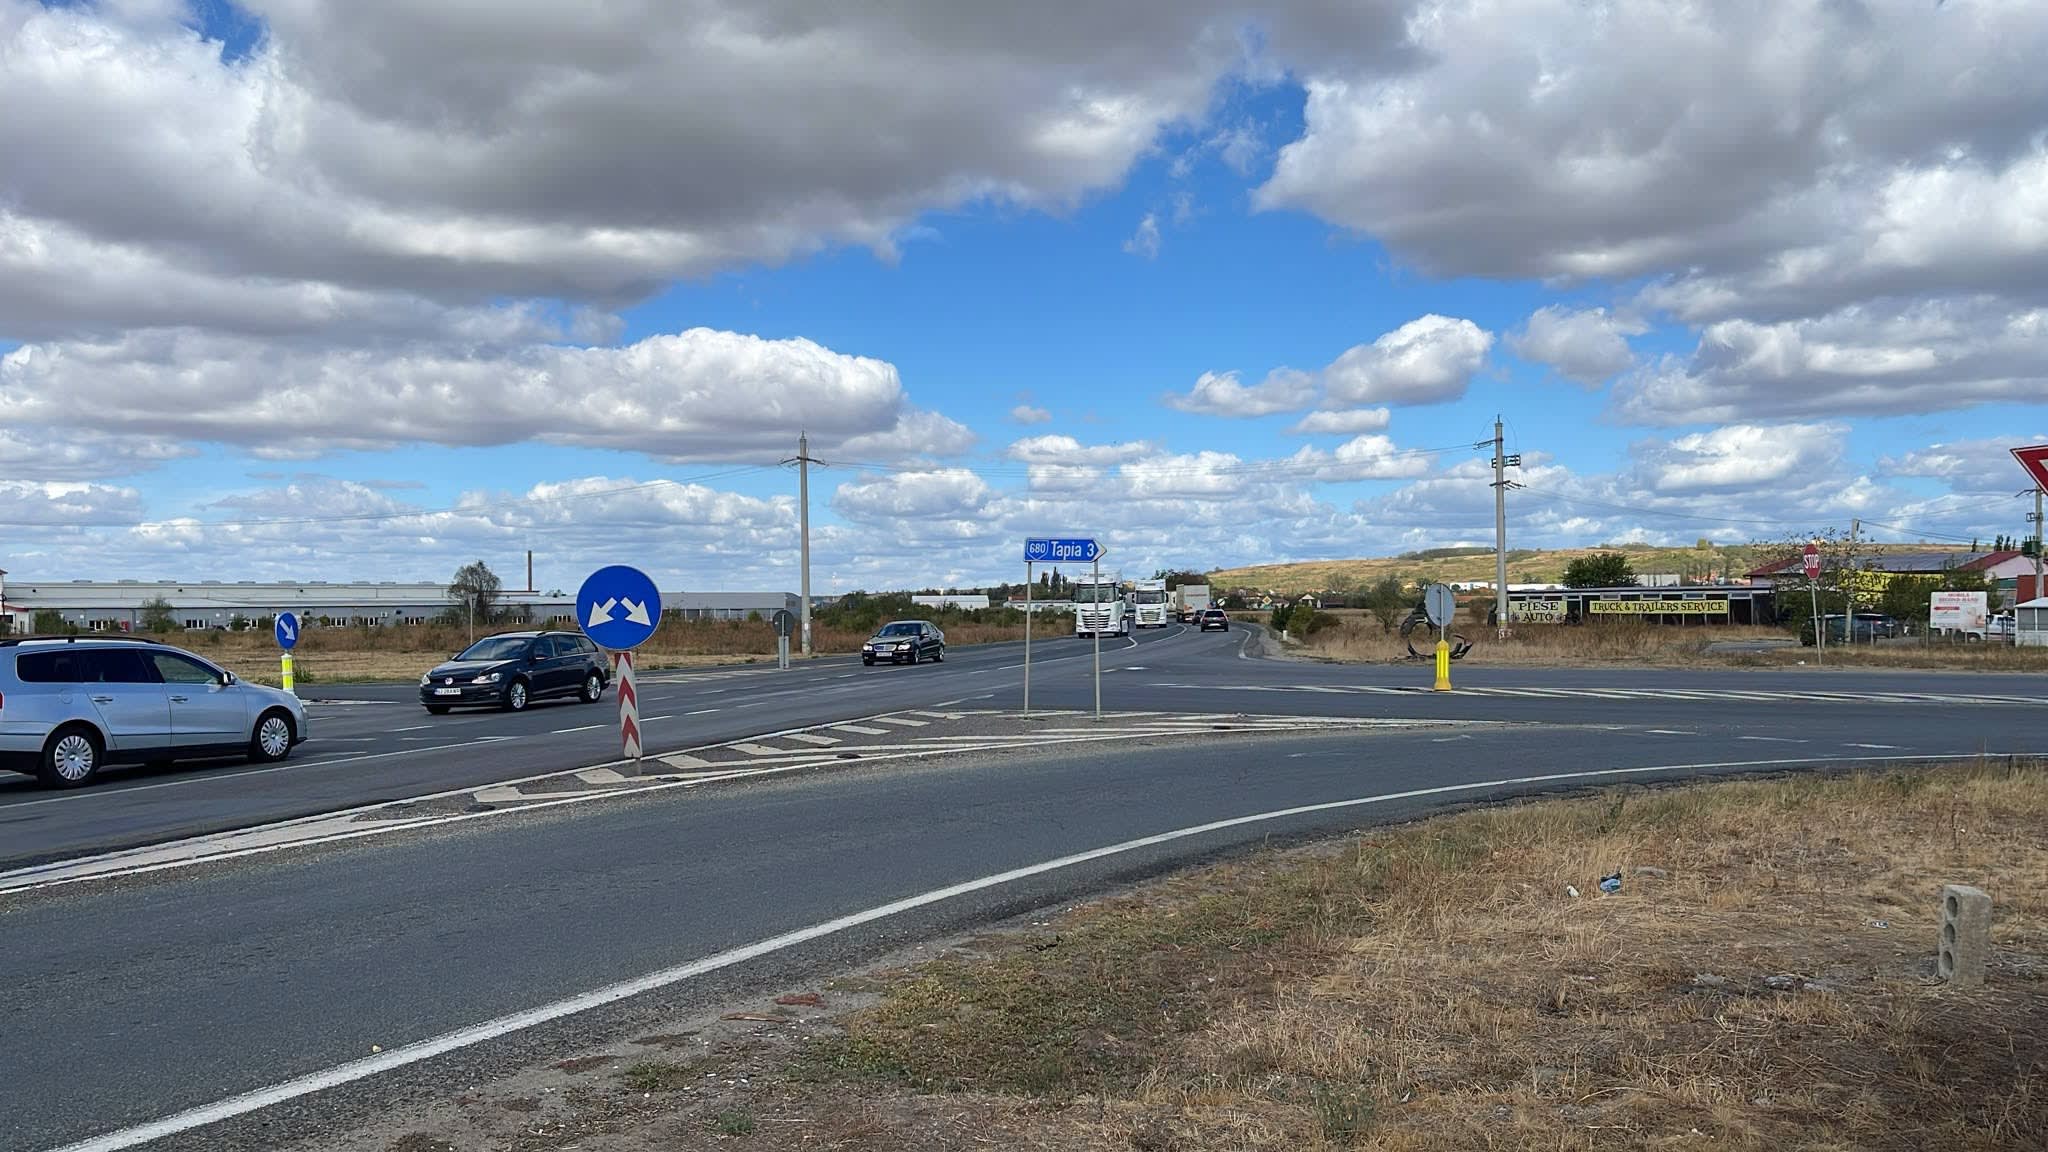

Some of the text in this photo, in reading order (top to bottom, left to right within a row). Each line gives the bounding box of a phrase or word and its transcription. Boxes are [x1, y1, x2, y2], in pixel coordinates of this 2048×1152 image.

[1029, 541, 1095, 560] 680 Tapia 3
[1804, 554, 1819, 569] STOP
[1519, 602, 1559, 611] PIESE
[1592, 602, 1725, 612] TRUCK & TRAILERS SERVICE
[1522, 612, 1553, 622] AUTO
